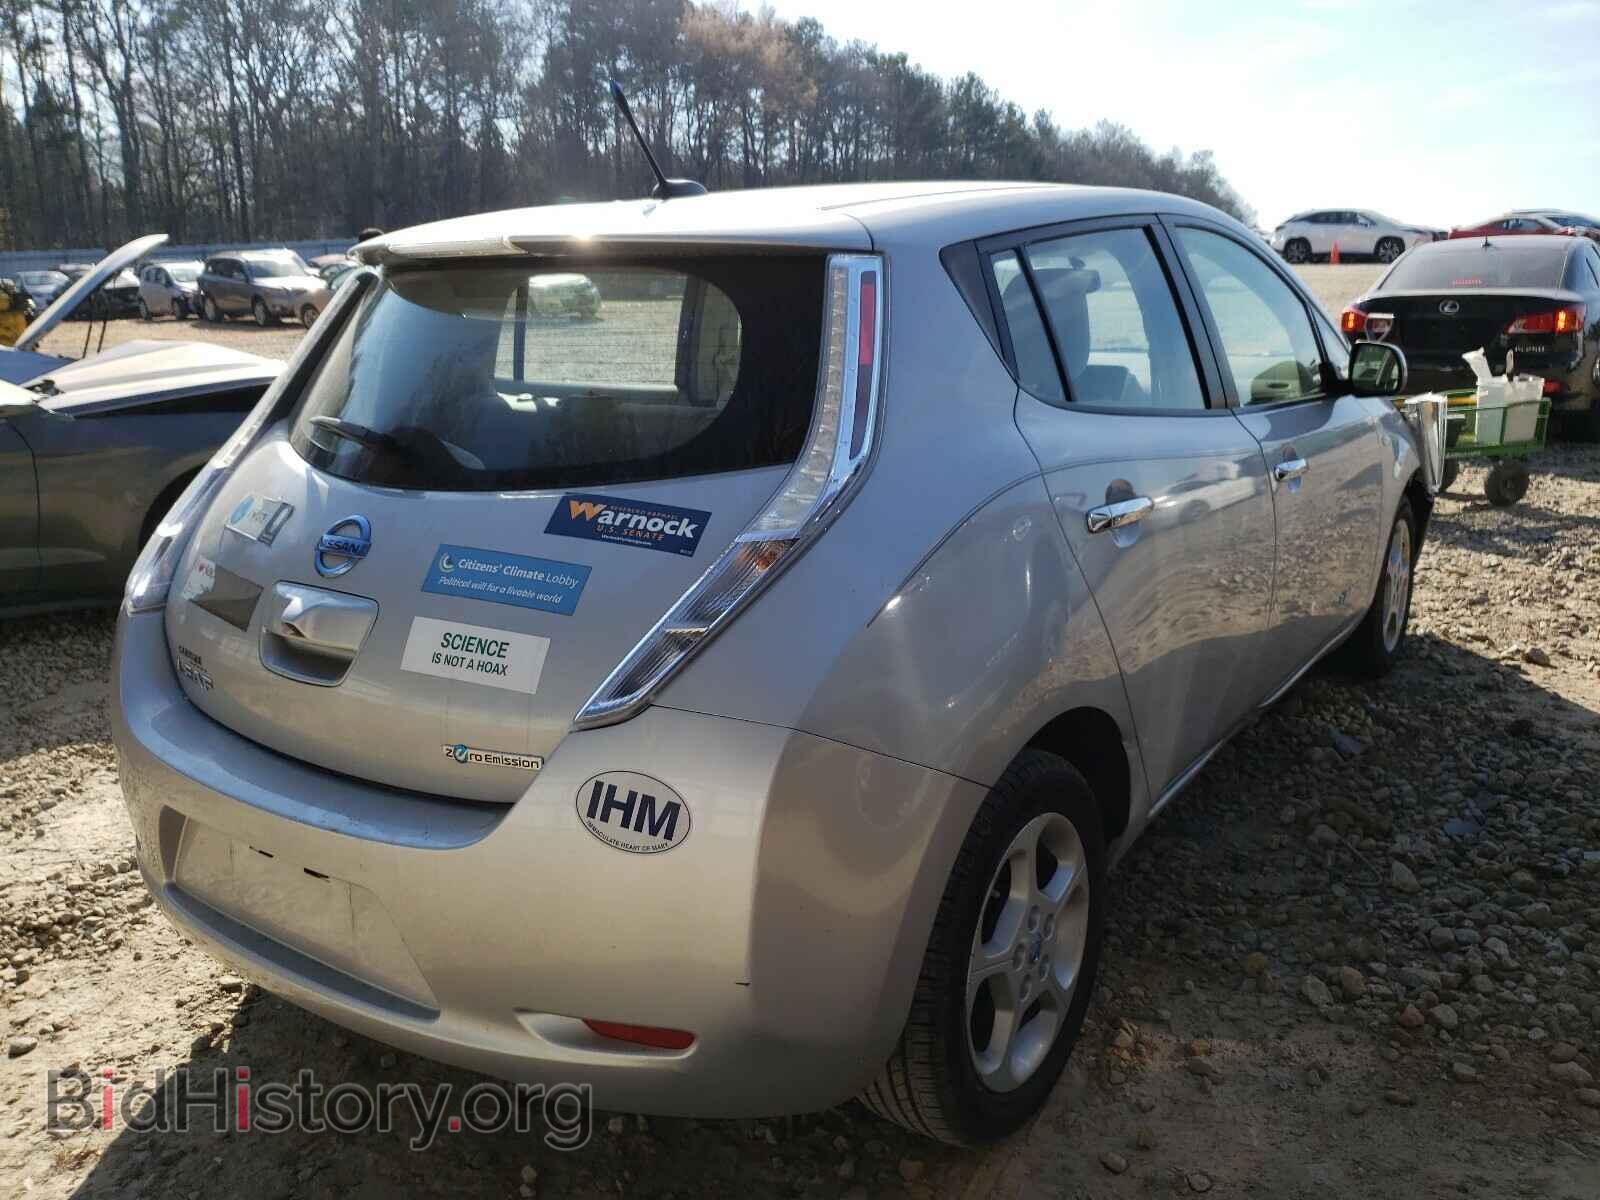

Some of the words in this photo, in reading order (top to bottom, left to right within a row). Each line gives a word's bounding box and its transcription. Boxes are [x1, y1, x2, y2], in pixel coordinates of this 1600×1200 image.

[569, 500, 699, 538] Warnock
[624, 528, 666, 541] SENATE
[457, 558, 503, 574] Citizens'
[503, 565, 545, 580] Climate
[545, 574, 580, 589] Lobby
[438, 576, 471, 589] Political
[471, 581, 487, 591] will
[486, 582, 499, 594] for
[536, 593, 562, 604] world
[440, 632, 510, 659] SCIENCE
[431, 652, 442, 664] IS
[443, 654, 466, 669] NOT
[466, 659, 474, 670] A
[476, 660, 508, 676] HOAX
[484, 754, 540, 769] Emission
[586, 779, 682, 841] IHM
